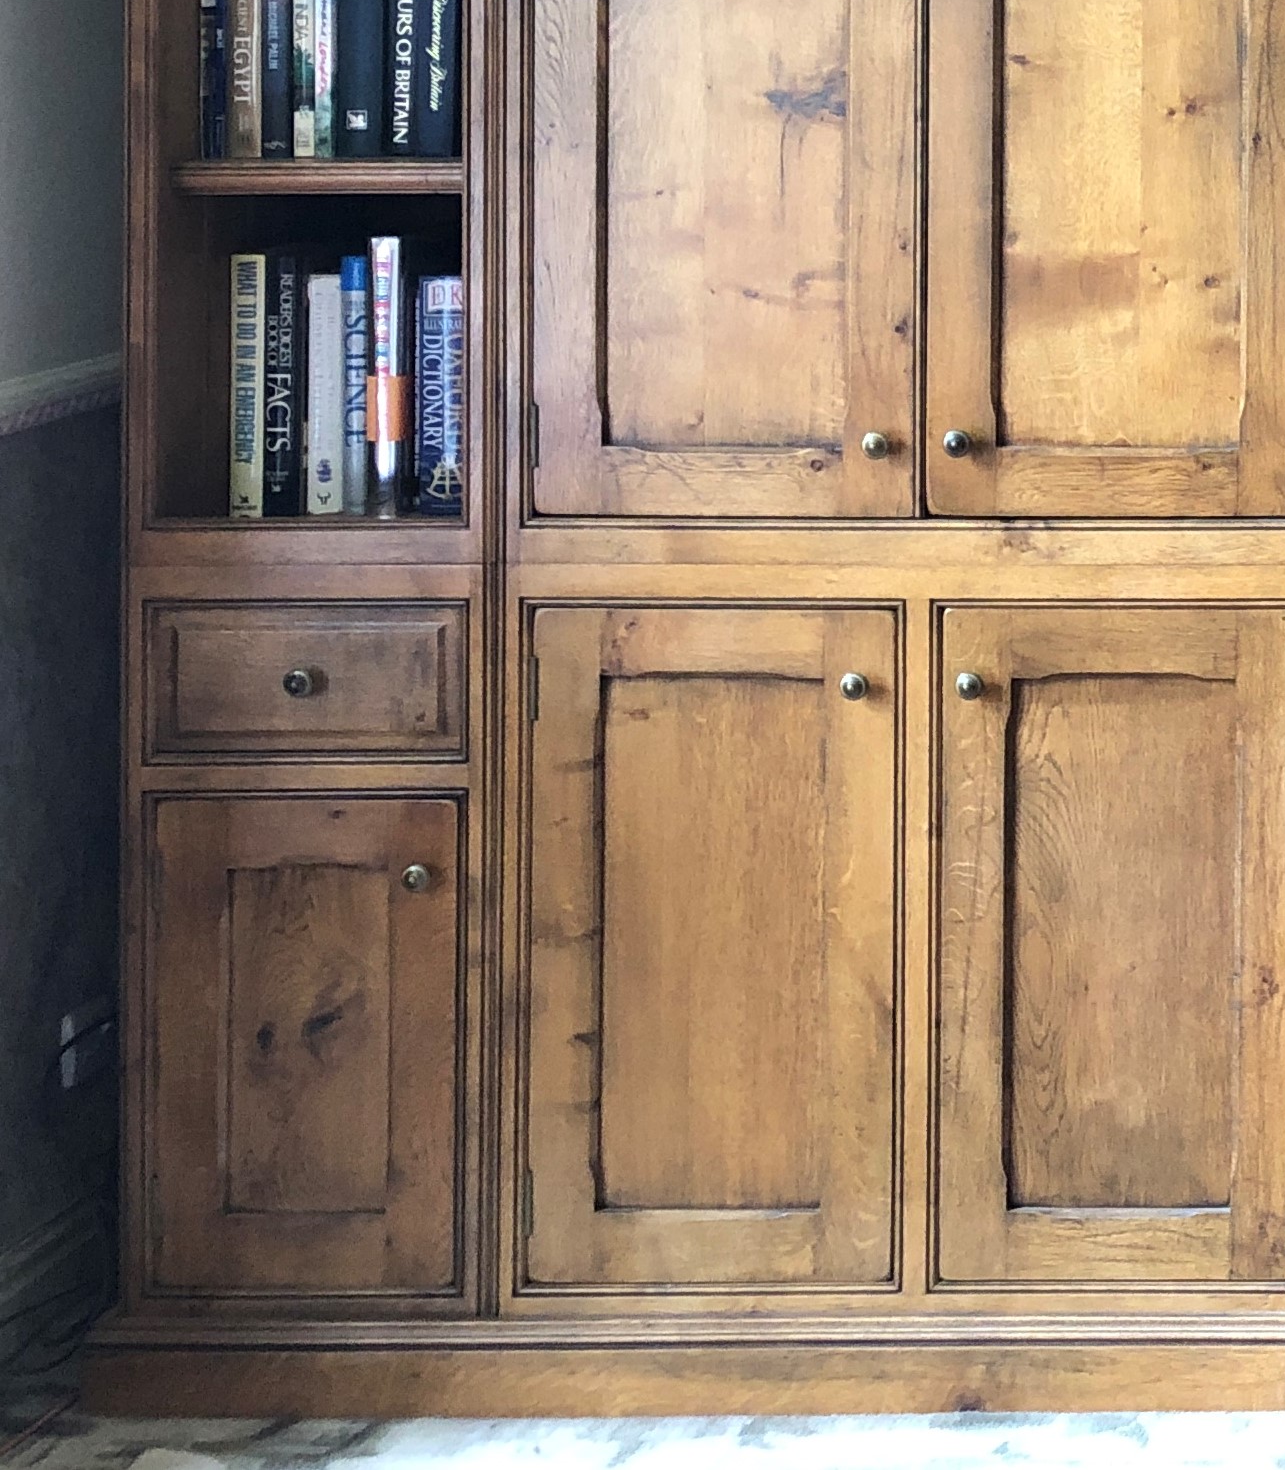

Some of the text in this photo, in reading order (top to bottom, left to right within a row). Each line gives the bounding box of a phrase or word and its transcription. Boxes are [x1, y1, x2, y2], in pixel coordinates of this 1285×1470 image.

[267, 0, 279, 40] MICHAEL
[293, 3, 309, 41] INDIA
[232, 36, 251, 105] EGYPT
[267, 42, 279, 70] PALIN
[317, 41, 331, 98] London
[395, 39, 413, 66] OF
[392, 69, 411, 144] BRITAIN
[429, 62, 449, 112] Britain
[431, 283, 463, 307] DK
[234, 261, 258, 464] WHAT TO DO IN AN EMERGENCY
[267, 315, 279, 367] BOOK OF
[279, 328, 293, 368] DIGEST
[344, 313, 367, 447] SCIENCE
[422, 333, 444, 450] DICTIONARY
[266, 372, 291, 452] FACTS
